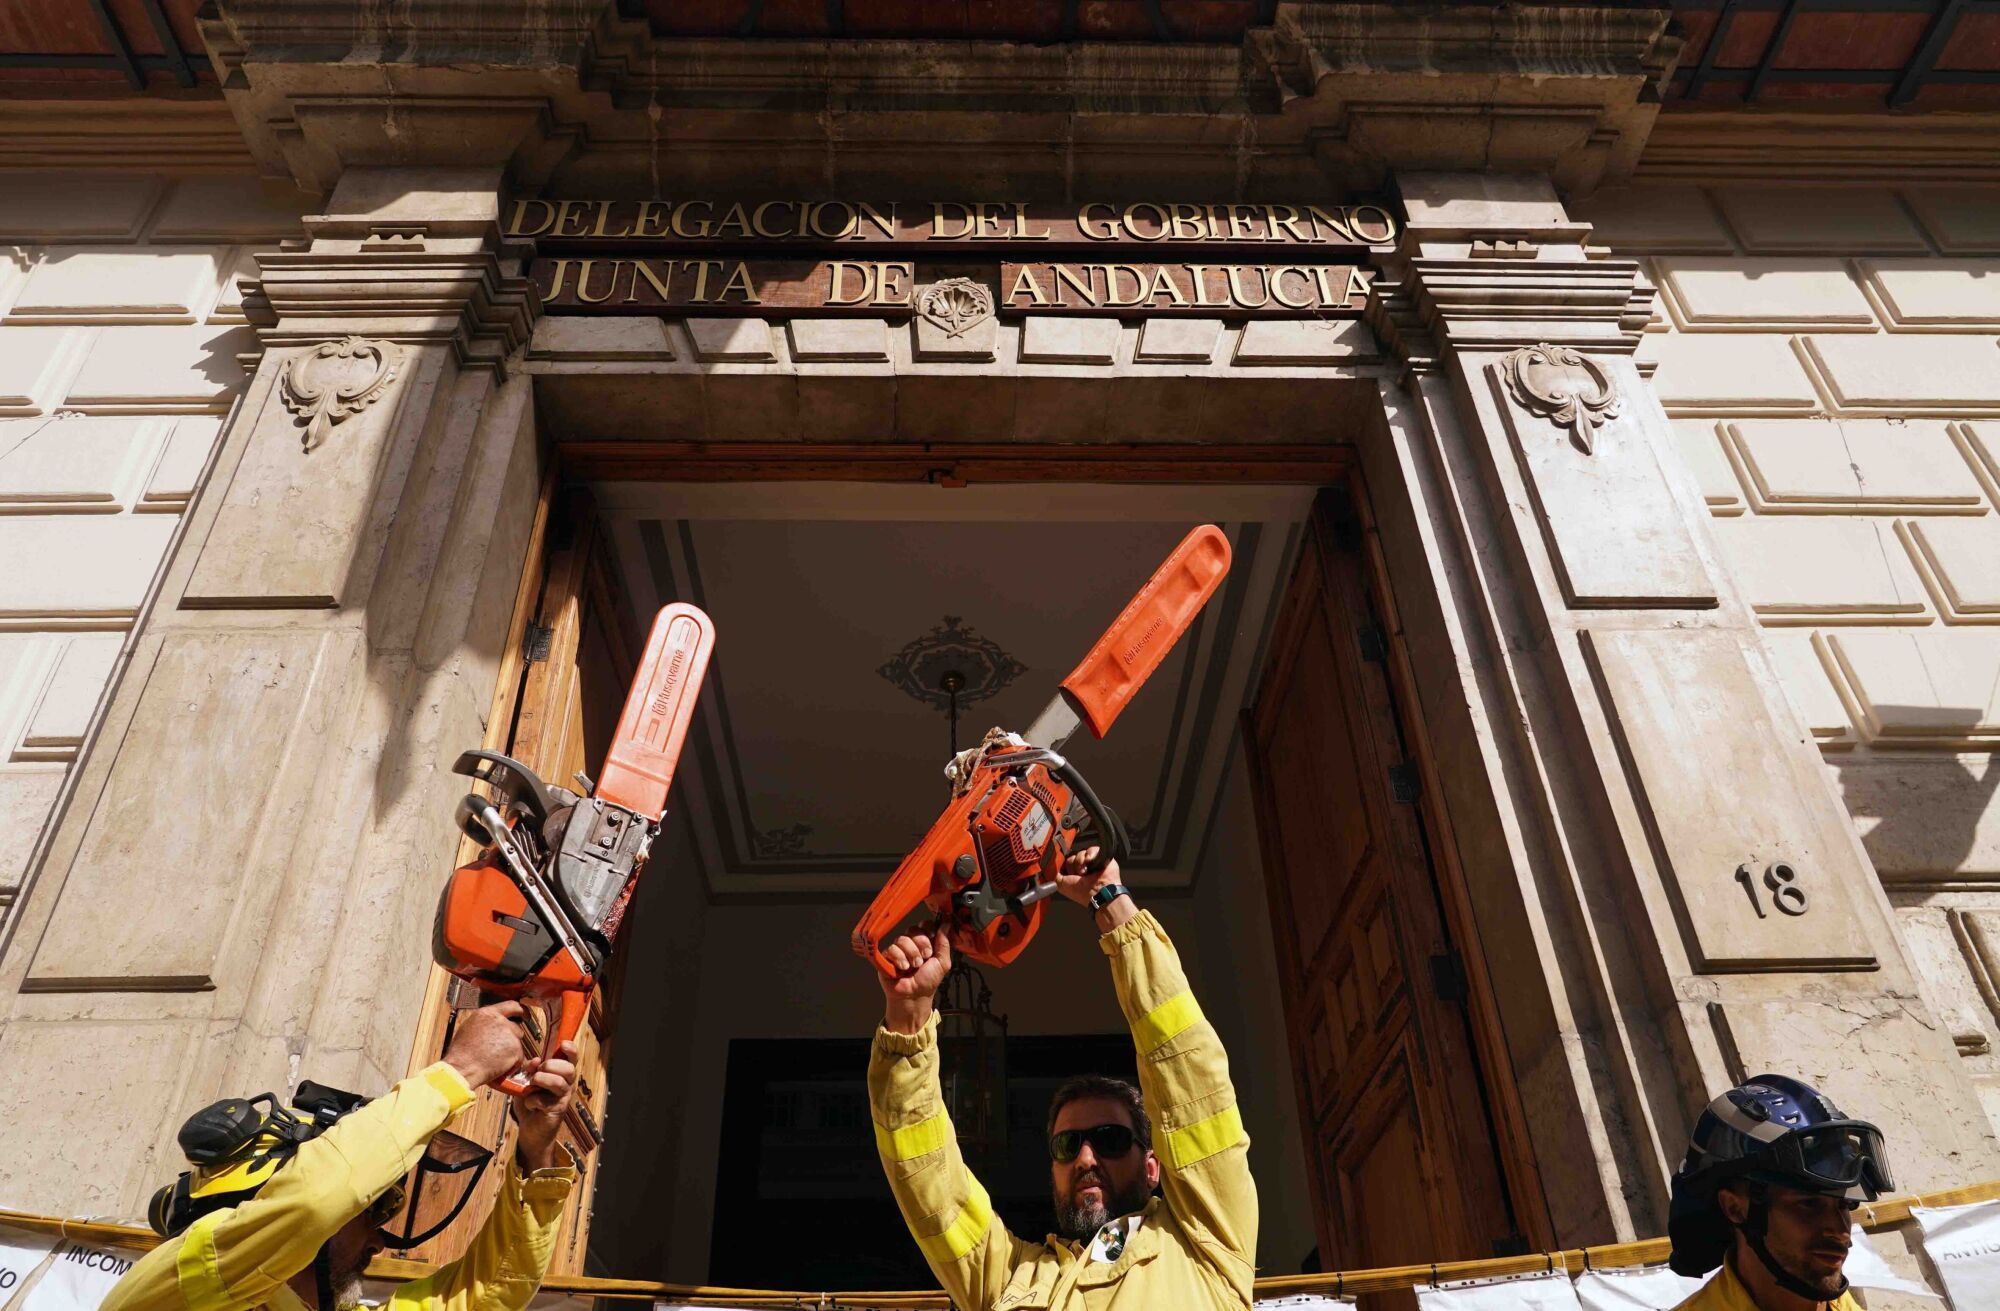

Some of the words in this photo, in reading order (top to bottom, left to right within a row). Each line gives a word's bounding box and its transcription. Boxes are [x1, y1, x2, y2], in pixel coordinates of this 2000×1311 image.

[503, 200, 899, 240] DELEGACION
[928, 201, 1050, 241] DEL
[1077, 201, 1397, 243] GOBIERNO
[541, 259, 762, 305] JUNTA
[824, 262, 912, 307] DE
[1003, 263, 1373, 309] ANDALUCIA
[656, 649, 684, 705] Husqvarna
[1734, 861, 1809, 919] 18
